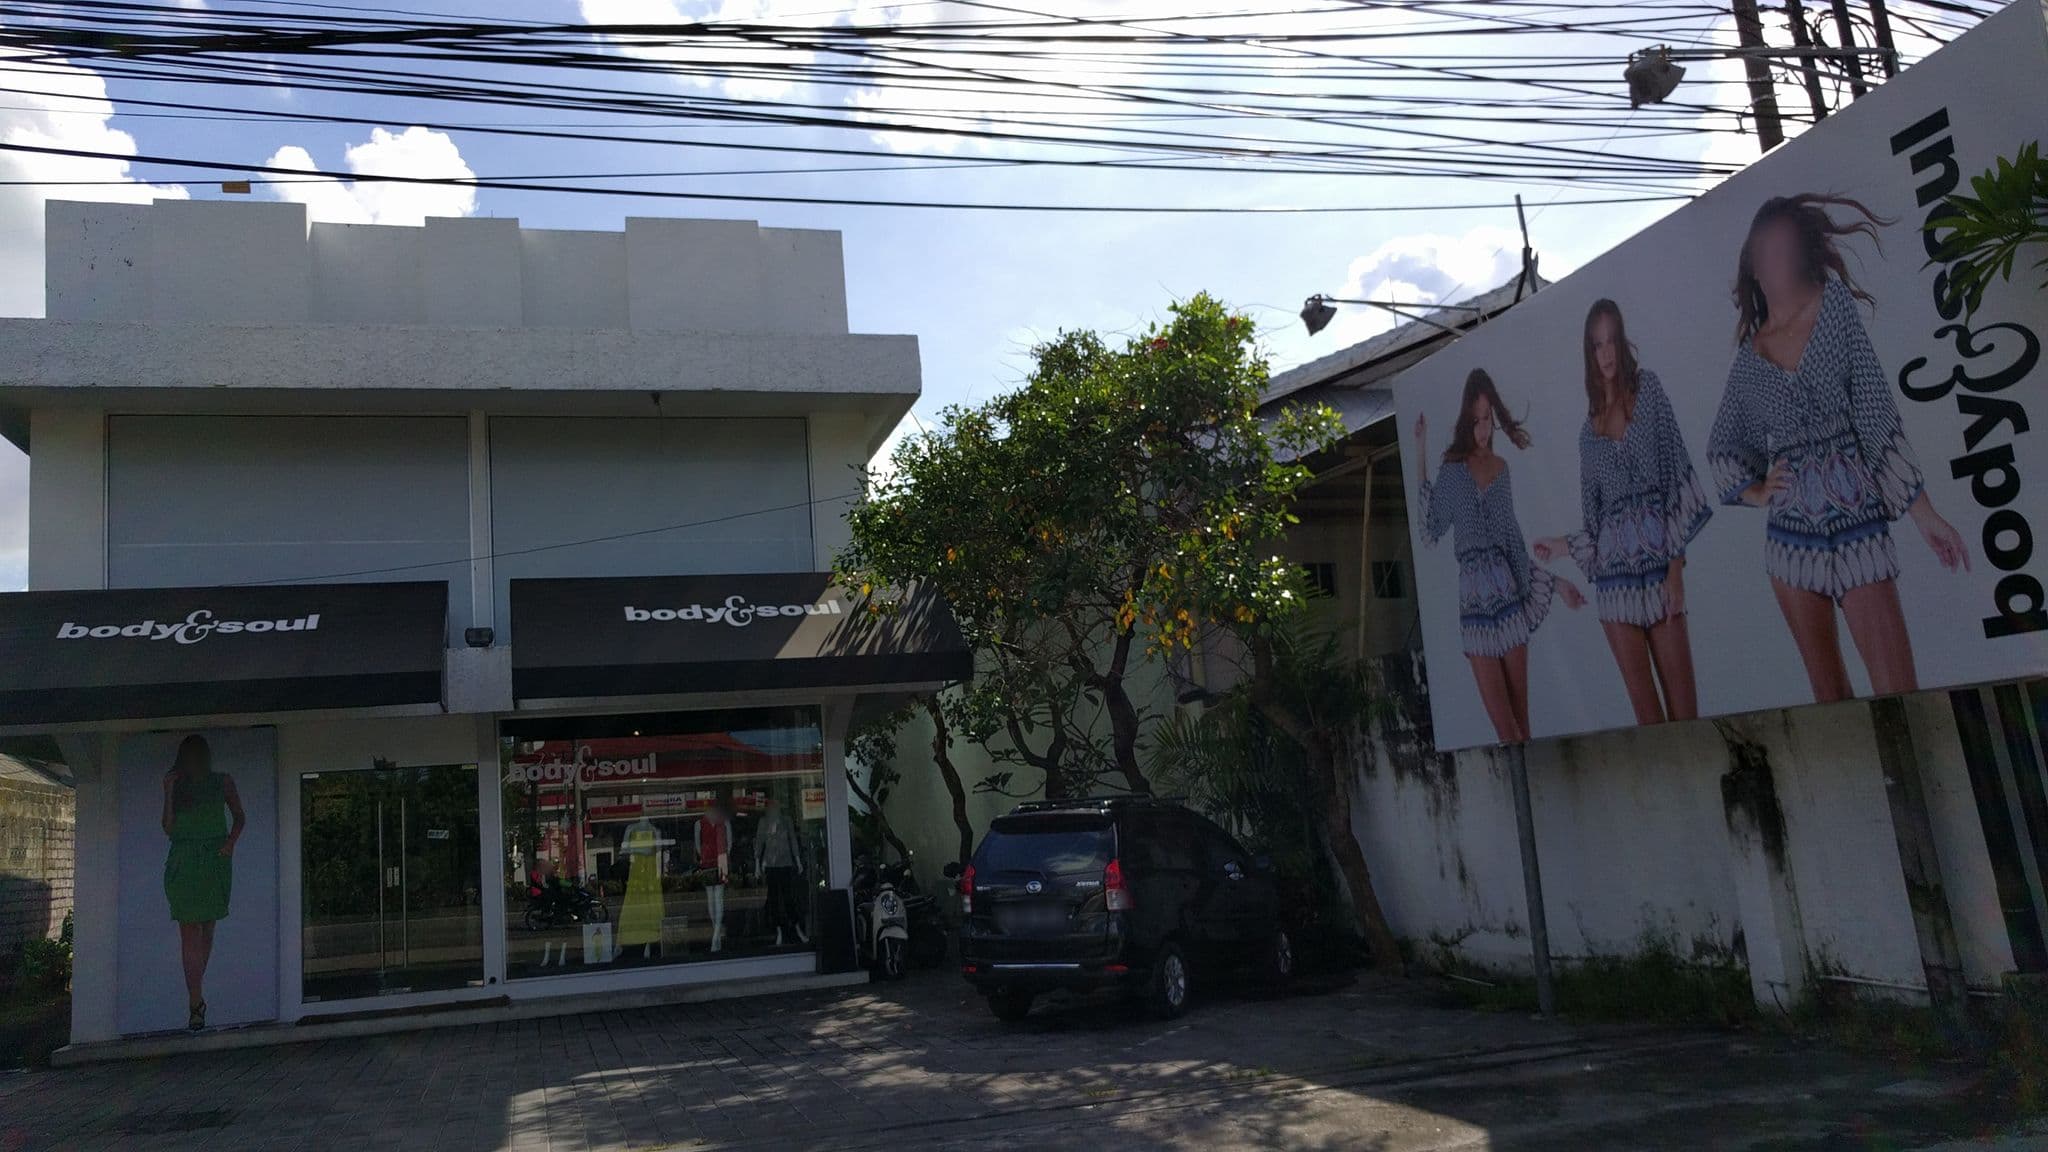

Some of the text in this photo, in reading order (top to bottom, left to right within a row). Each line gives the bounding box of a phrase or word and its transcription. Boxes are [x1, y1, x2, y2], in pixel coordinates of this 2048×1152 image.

[57, 609, 320, 644] body&soul
[624, 595, 841, 627] body&soul
[509, 745, 657, 791] body&soul
